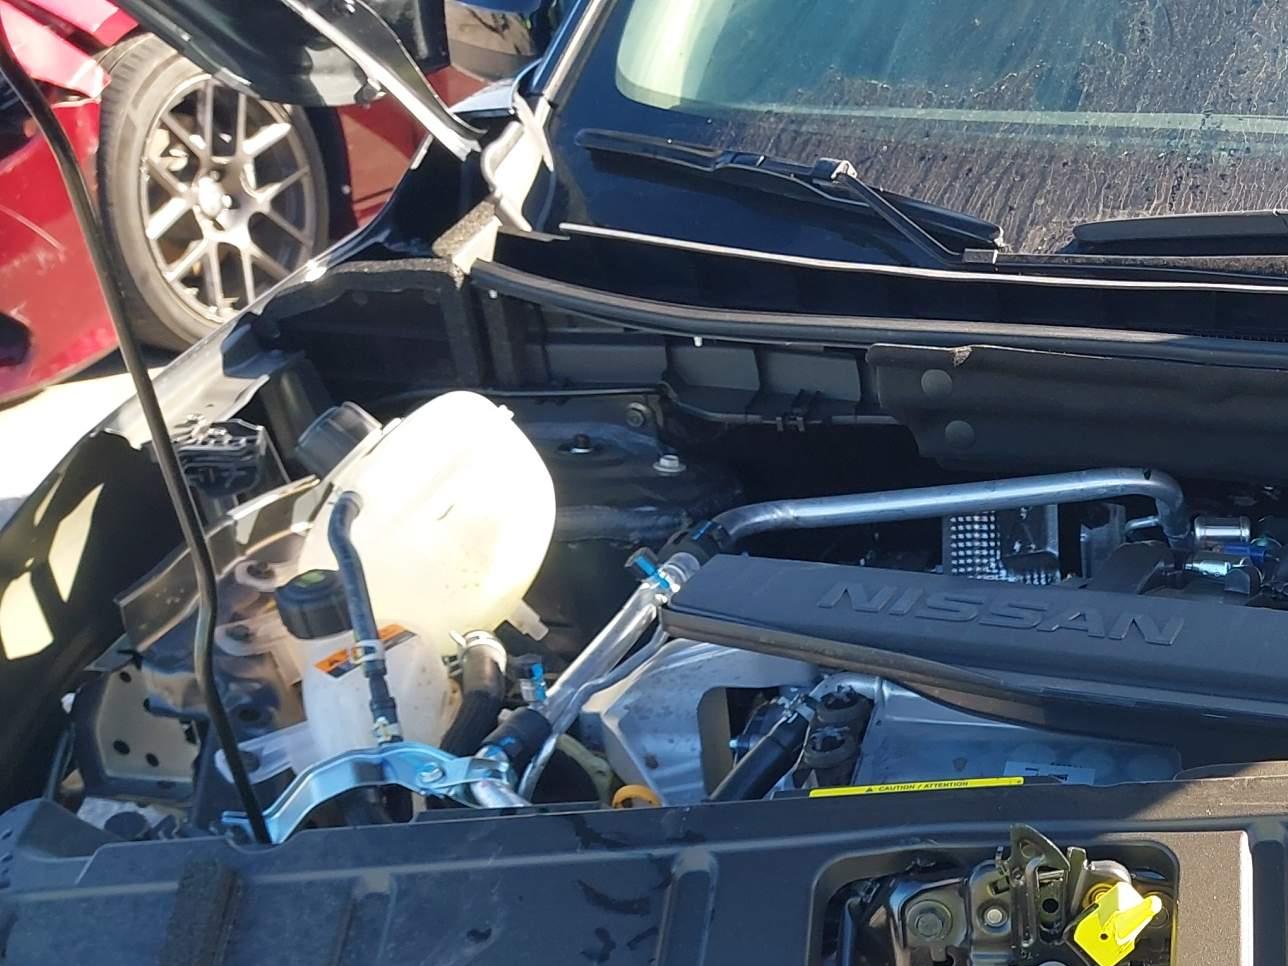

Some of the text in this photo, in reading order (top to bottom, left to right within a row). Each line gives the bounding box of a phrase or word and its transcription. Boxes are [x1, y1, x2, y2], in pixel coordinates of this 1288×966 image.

[817, 582, 1185, 646] NISSAN
[878, 784, 915, 792] CAUTION
[924, 781, 969, 789] ATTENTION
